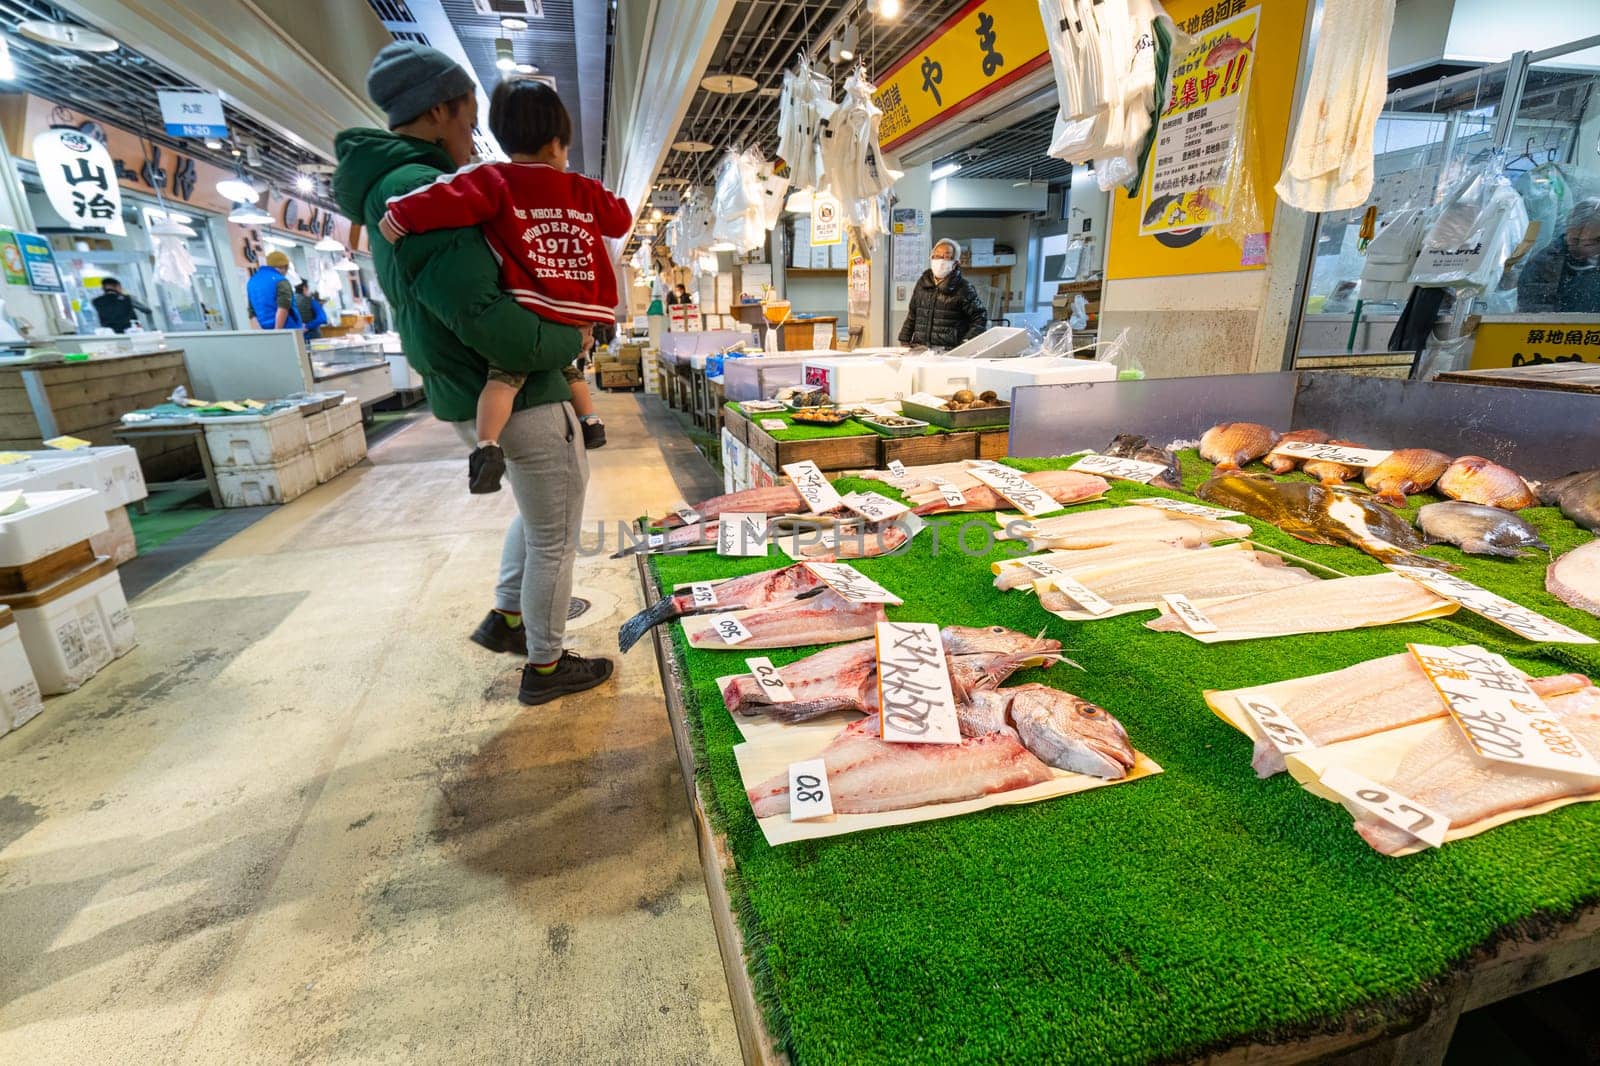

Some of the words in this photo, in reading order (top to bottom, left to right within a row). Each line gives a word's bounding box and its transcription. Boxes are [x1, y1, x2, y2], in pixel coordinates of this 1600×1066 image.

[183, 125, 211, 136] N-20
[61, 158, 116, 220] 山治
[530, 208, 563, 220] WHOLE
[566, 208, 594, 223] WORLD
[522, 221, 595, 246] WONDERFUL
[536, 238, 583, 254] 1971
[528, 250, 594, 268] RESPECT
[535, 267, 595, 280] XXX-KIDS
[719, 620, 742, 638] 0.95
[756, 665, 784, 688] 0.8
[1247, 700, 1304, 746] 0.65
[796, 774, 824, 803] 0.8
